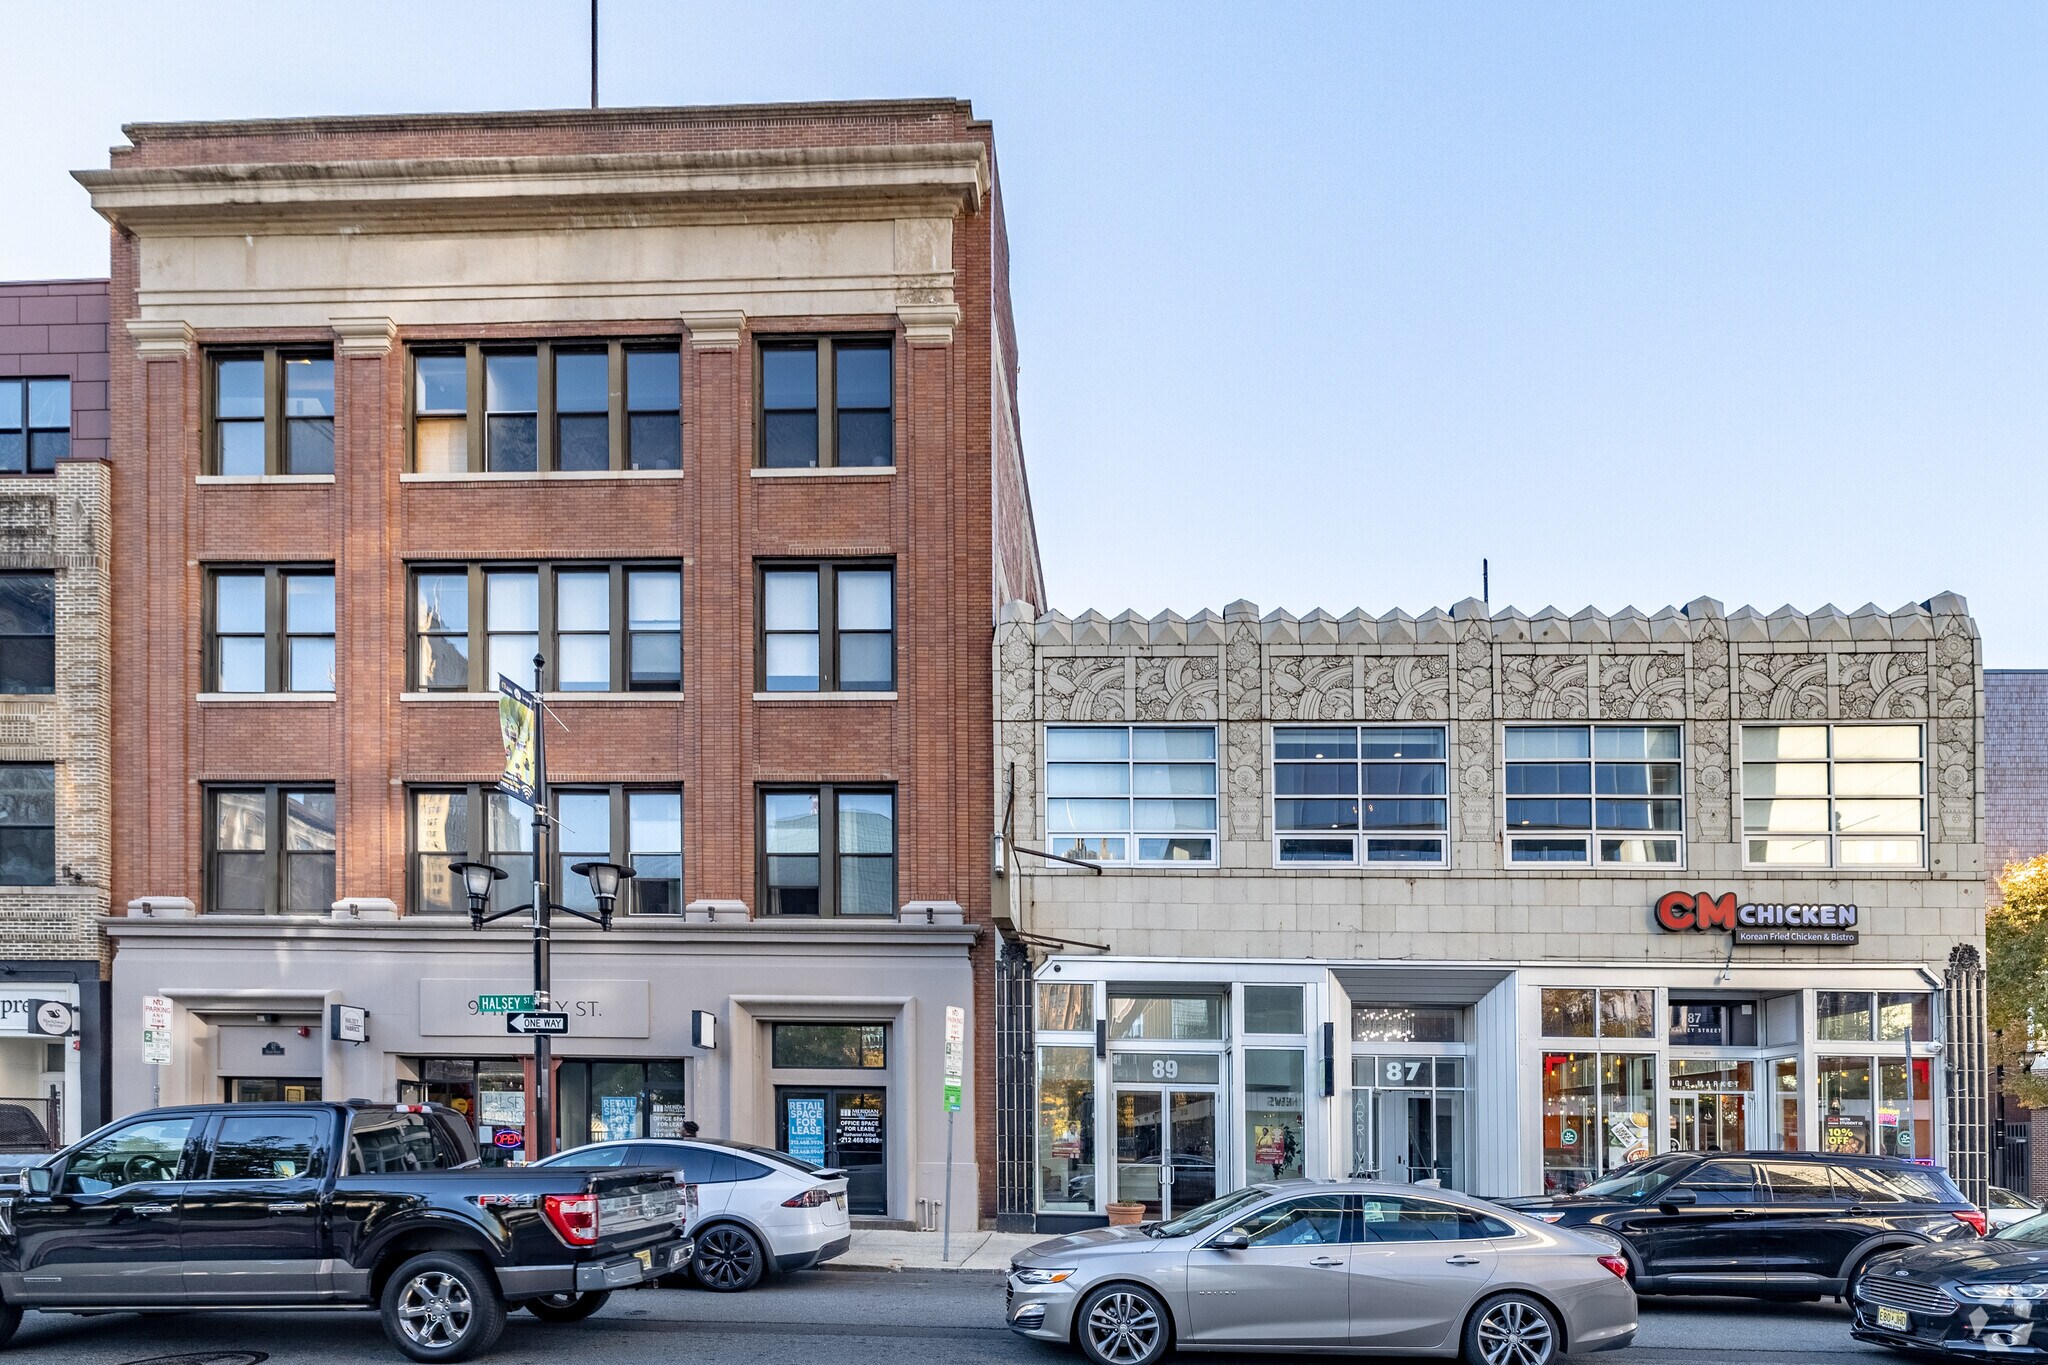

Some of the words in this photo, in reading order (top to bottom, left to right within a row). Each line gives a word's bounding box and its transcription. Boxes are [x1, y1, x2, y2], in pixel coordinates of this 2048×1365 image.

[1655, 891, 1737, 930] CM
[1738, 904, 1857, 926] CHICKEN
[1740, 933, 1769, 941] Korean
[1770, 933, 1790, 941] Fried
[1791, 933, 1822, 941] Chicken
[1823, 933, 1830, 941] &
[1831, 933, 1855, 941] Bistro
[482, 996, 520, 1010] HALSEY
[145, 1006, 171, 1014] PARKING
[524, 1018, 541, 1028] ONE
[543, 1018, 562, 1028] WAY
[1687, 1013, 1701, 1024] 87
[1152, 1060, 1178, 1078] 89
[1386, 1062, 1421, 1081] 87
[1697, 1080, 1739, 1088] MARKET
[603, 1099, 637, 1108] RETAIL
[789, 1102, 824, 1110] RETAIL
[604, 1107, 635, 1116] SPACE
[791, 1110, 822, 1119] SPACE
[610, 1116, 630, 1124] FOR
[796, 1118, 817, 1127] FOR
[605, 1123, 636, 1132] EASE
[791, 1126, 822, 1135] LEASE
[1828, 1128, 1854, 1137] 10%
[494, 1134, 521, 1144] OPEN
[1354, 1098, 1366, 1177] ARRIVA
[1828, 1137, 1849, 1145] OFF
[478, 1194, 534, 1208] FX4
